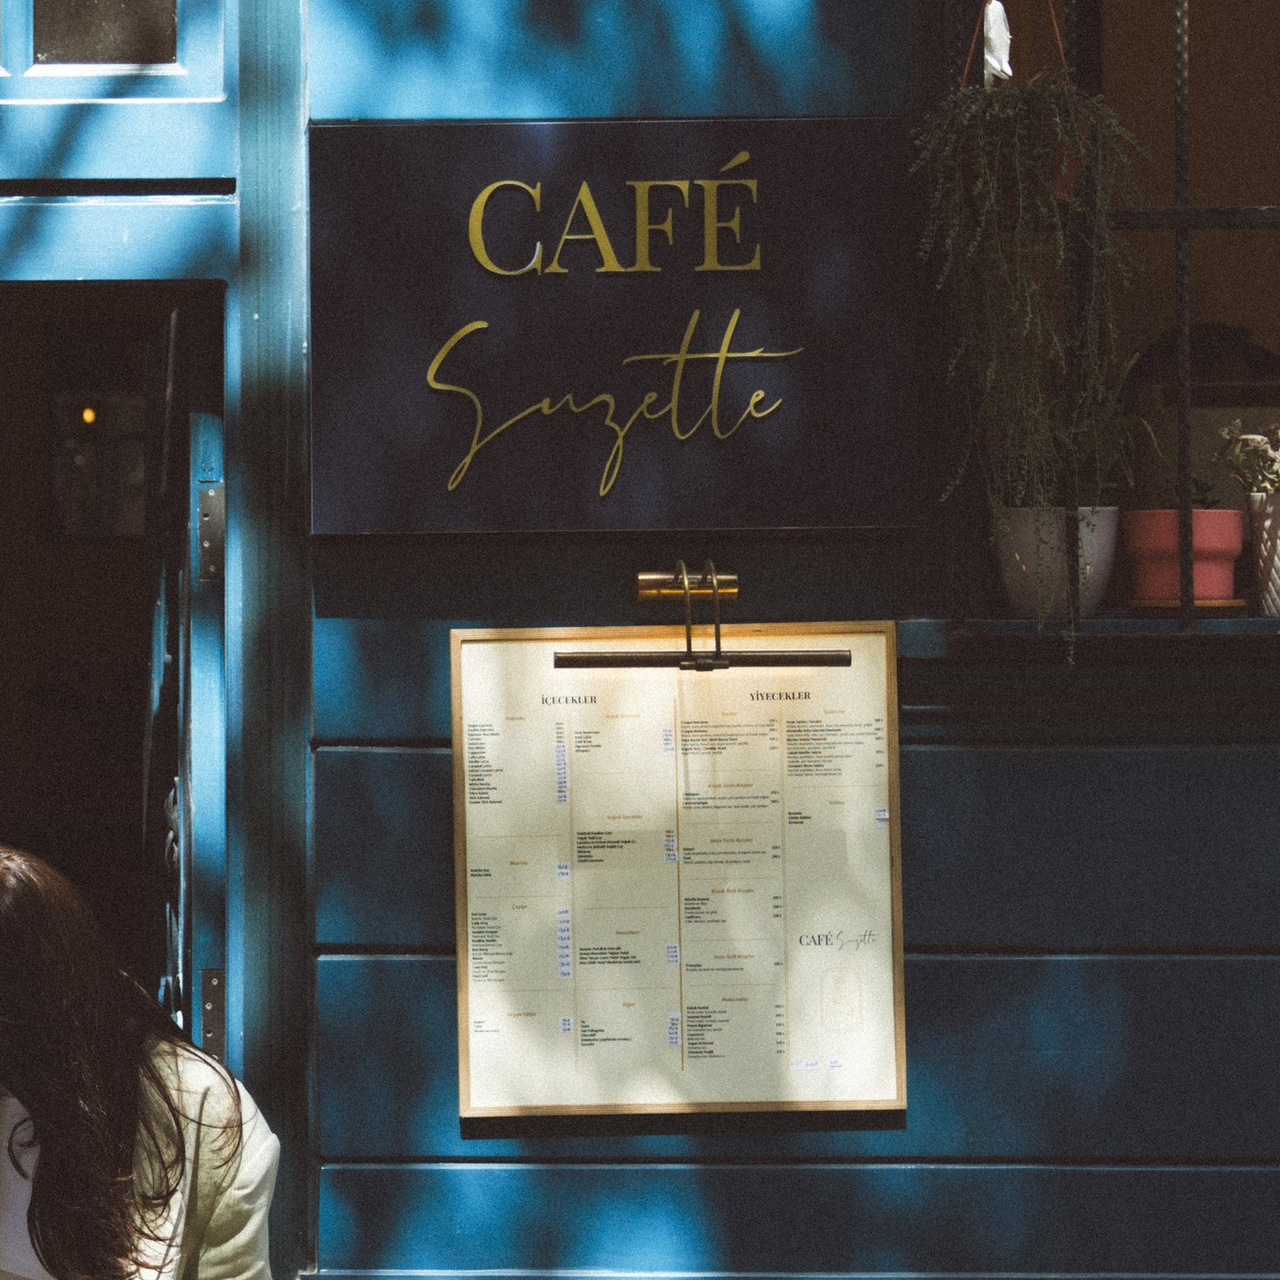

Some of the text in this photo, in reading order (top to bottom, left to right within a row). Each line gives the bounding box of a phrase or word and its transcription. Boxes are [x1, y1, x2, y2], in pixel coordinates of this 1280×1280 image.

[468, 150, 762, 276] CAFÉ
[426, 308, 805, 498] Suzette
[541, 694, 597, 706] İÇECEKLER
[750, 690, 811, 701] YİYECEKLER
[799, 931, 834, 946] CAFÉ
